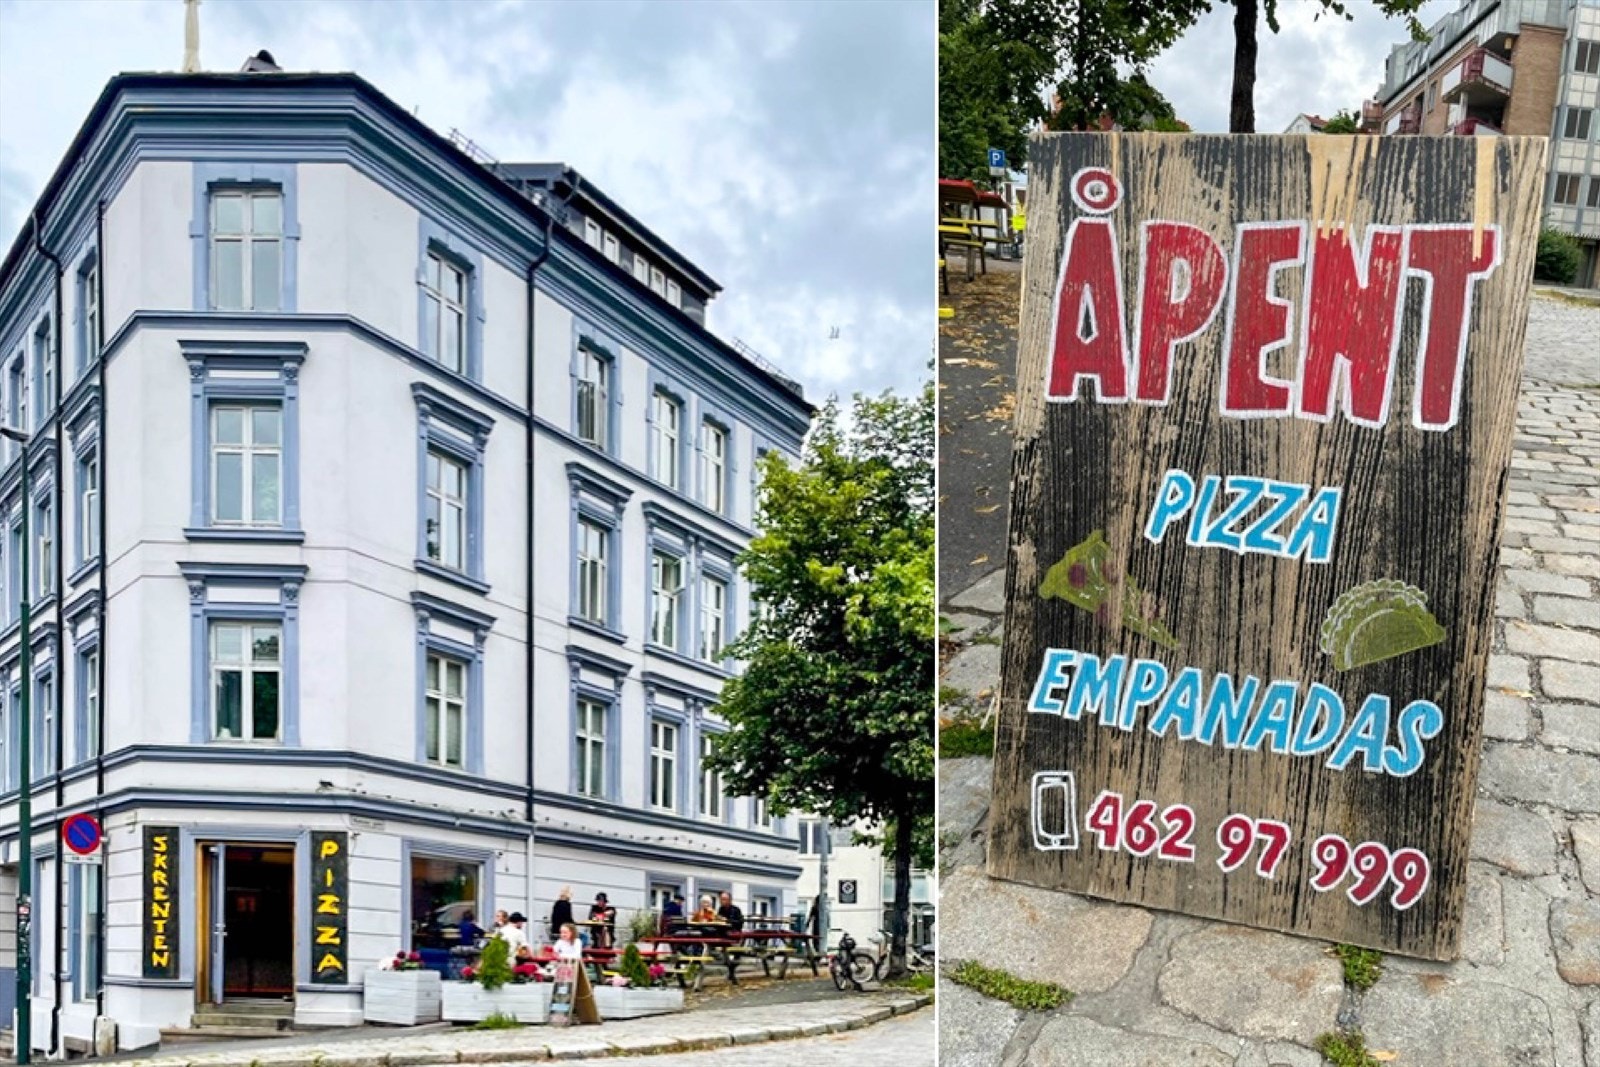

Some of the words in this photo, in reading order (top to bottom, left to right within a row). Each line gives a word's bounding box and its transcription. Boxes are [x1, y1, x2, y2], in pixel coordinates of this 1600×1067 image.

[992, 152, 1001, 165] P
[1046, 166, 1501, 432] ÅPENT
[1144, 468, 1342, 564] PIZZA
[1027, 648, 1444, 778] EMPANADAS
[152, 836, 171, 967] SKRENTEN
[315, 840, 343, 973] PIZZA
[1085, 790, 1196, 862] 462
[1216, 813, 1291, 878] 97
[1309, 834, 1431, 911] 999
